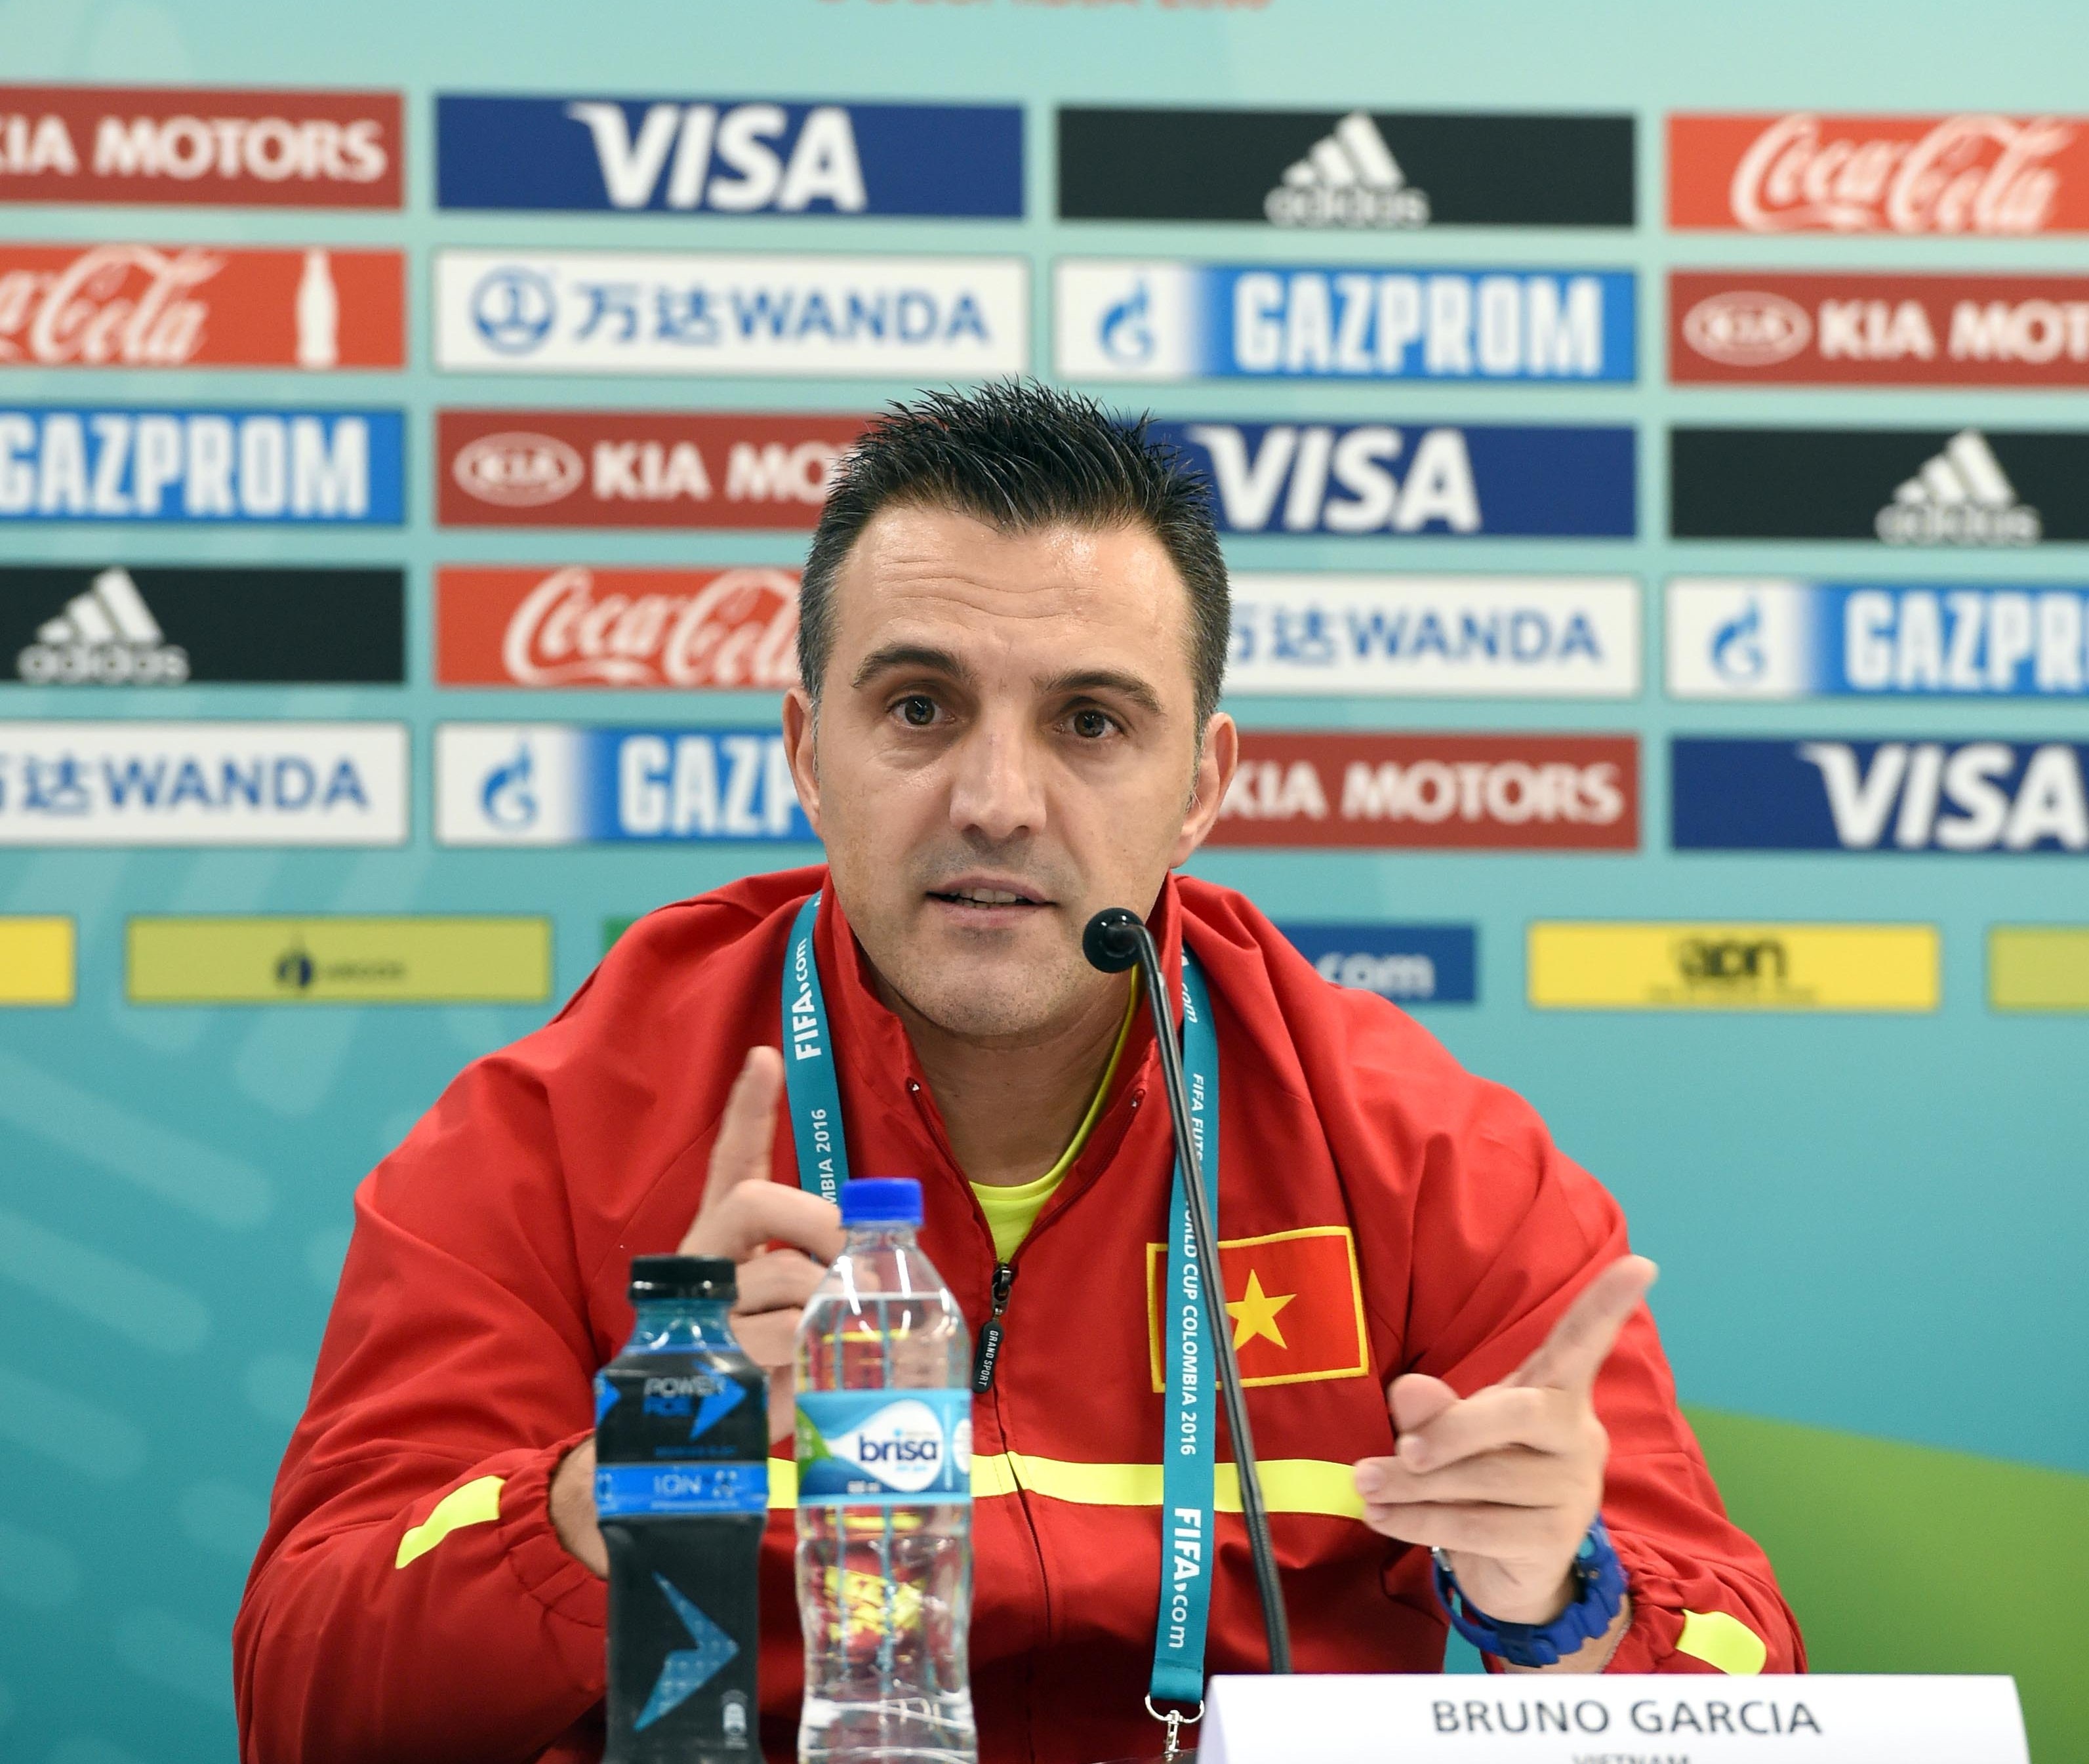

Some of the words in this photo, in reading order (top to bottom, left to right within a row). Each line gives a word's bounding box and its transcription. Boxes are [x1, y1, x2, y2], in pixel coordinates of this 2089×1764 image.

[0, 115, 77, 174] IA
[94, 117, 386, 182] MOTORS
[565, 102, 867, 211] VISA
[1263, 188, 1431, 229] adidas
[575, 281, 720, 346] 万达
[728, 287, 989, 345] WANDA
[1233, 272, 1603, 375] GAZPROM
[1819, 300, 1935, 358] KIA
[1949, 299, 2089, 363] MOT
[0, 413, 369, 517] GAZPROM
[594, 442, 711, 500] KIA
[1188, 426, 1481, 531] VISA
[1875, 503, 2041, 546] adidas
[18, 644, 190, 684] adidas
[1345, 609, 1602, 664] WANDA
[1844, 590, 2089, 693] GAZPR
[101, 755, 369, 812] WANDA
[619, 736, 798, 836] GAZP
[1342, 761, 1624, 824] MOTORS
[1798, 743, 2089, 848] VISA
[792, 938, 822, 1060] FIFA.com
[1192, 1073, 1204, 1111] FIFA
[811, 1109, 831, 1153] 2016
[819, 1158, 838, 1208] MBIA
[1183, 1264, 1198, 1300] CUP
[978, 1359, 993, 1387] SPORT
[985, 1330, 998, 1359] GRAND
[1181, 1304, 1198, 1406] COLOMBIA
[859, 1428, 937, 1462] brisa
[1181, 1412, 1197, 1456] 2016
[1169, 1508, 1202, 1648] FIFA.com
[1431, 1699, 1610, 1733] BRUNO
[1630, 1699, 1823, 1734] GARCIA
